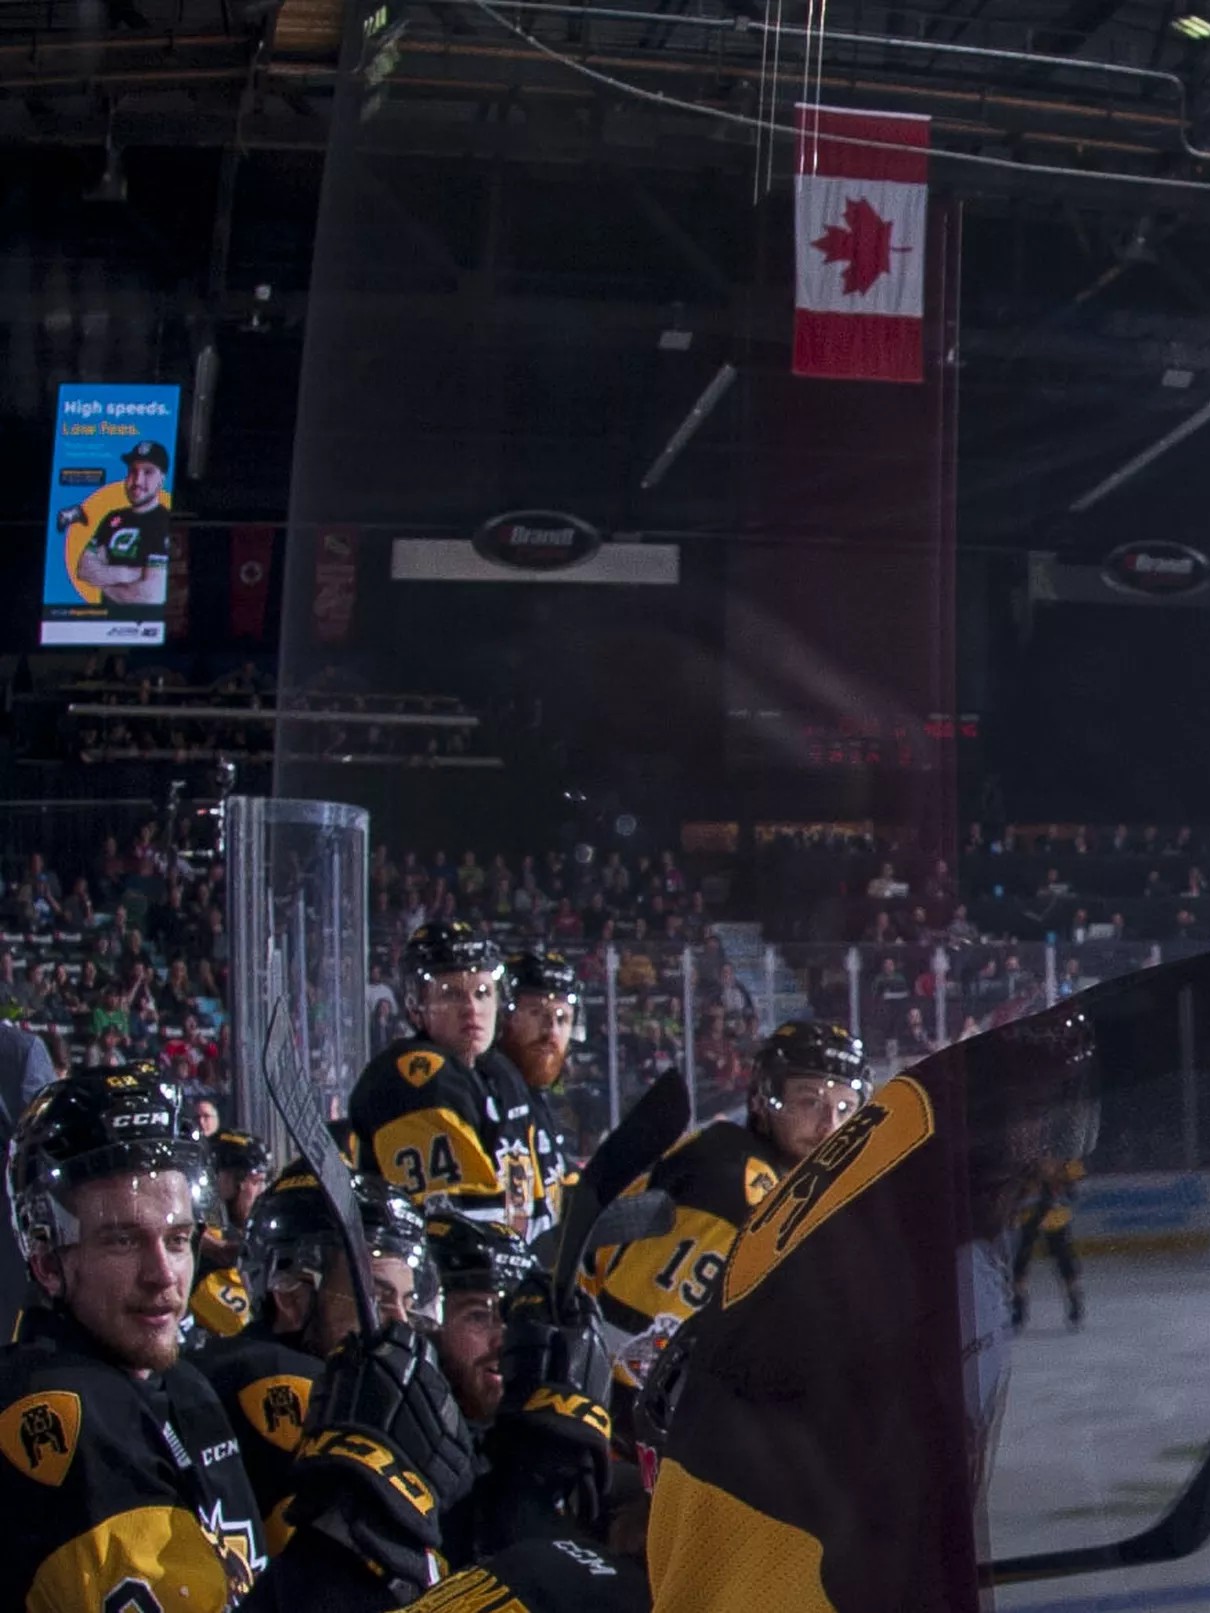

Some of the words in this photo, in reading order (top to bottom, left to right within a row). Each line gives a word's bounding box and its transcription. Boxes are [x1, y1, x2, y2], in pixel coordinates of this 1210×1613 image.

[64, 400, 102, 418] High
[106, 402, 170, 418] speeds.
[62, 422, 97, 436] Low
[113, 1112, 169, 1128] CCM
[394, 1131, 463, 1194] 34
[654, 1237, 728, 1309] 19
[202, 1438, 239, 1467] CCM
